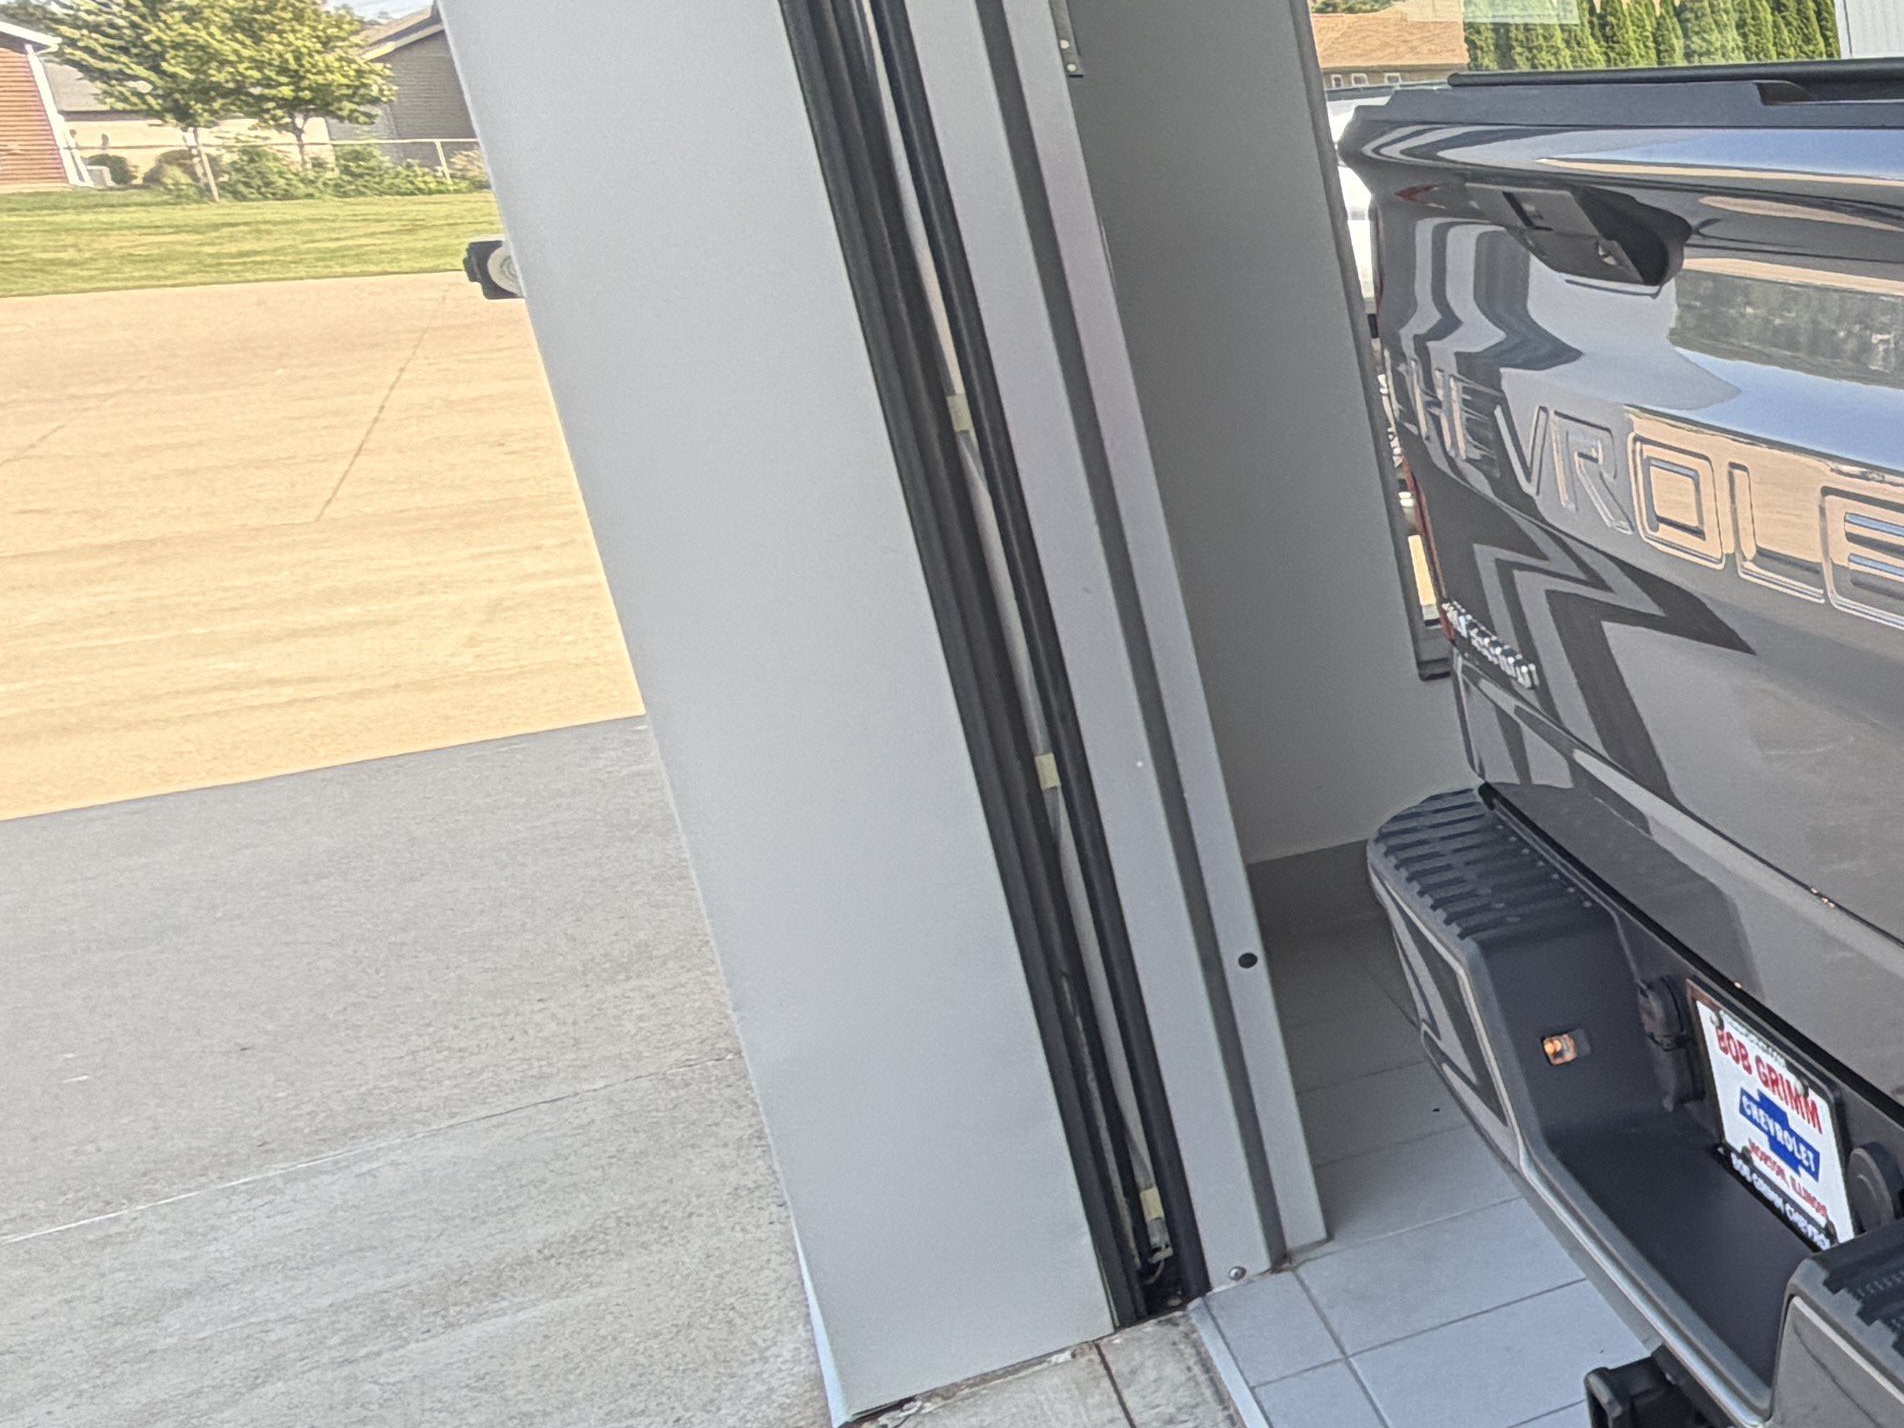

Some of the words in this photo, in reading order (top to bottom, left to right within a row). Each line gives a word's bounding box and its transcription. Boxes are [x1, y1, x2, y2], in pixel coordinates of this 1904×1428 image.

[1717, 1028, 1752, 1075] BOB
[1755, 1055, 1822, 1135] GRIMM
[1742, 1094, 1816, 1172] CHEVROLET
